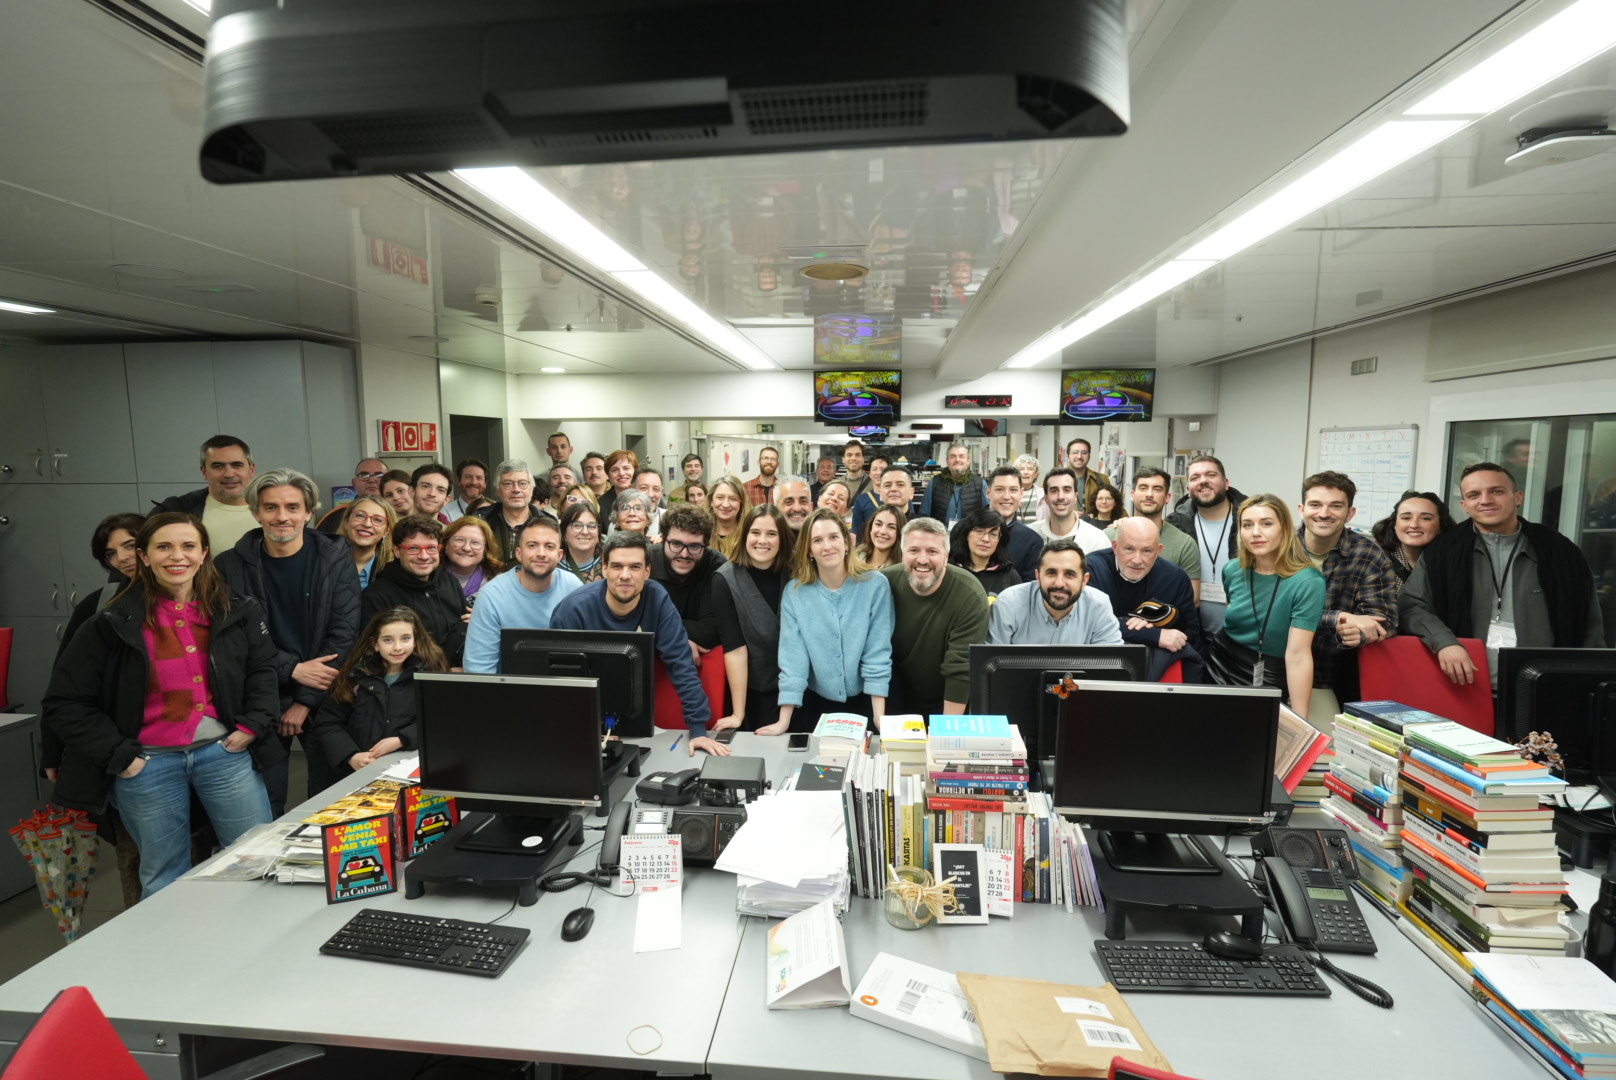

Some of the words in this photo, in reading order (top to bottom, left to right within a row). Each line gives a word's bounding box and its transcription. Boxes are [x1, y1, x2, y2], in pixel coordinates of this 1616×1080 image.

[334, 821, 382, 836] L'AMOR
[340, 830, 378, 842] VENIA
[330, 842, 359, 853] AMB
[361, 836, 388, 848] TAXI
[337, 889, 350, 898] La
[350, 884, 387, 896] Cubana
